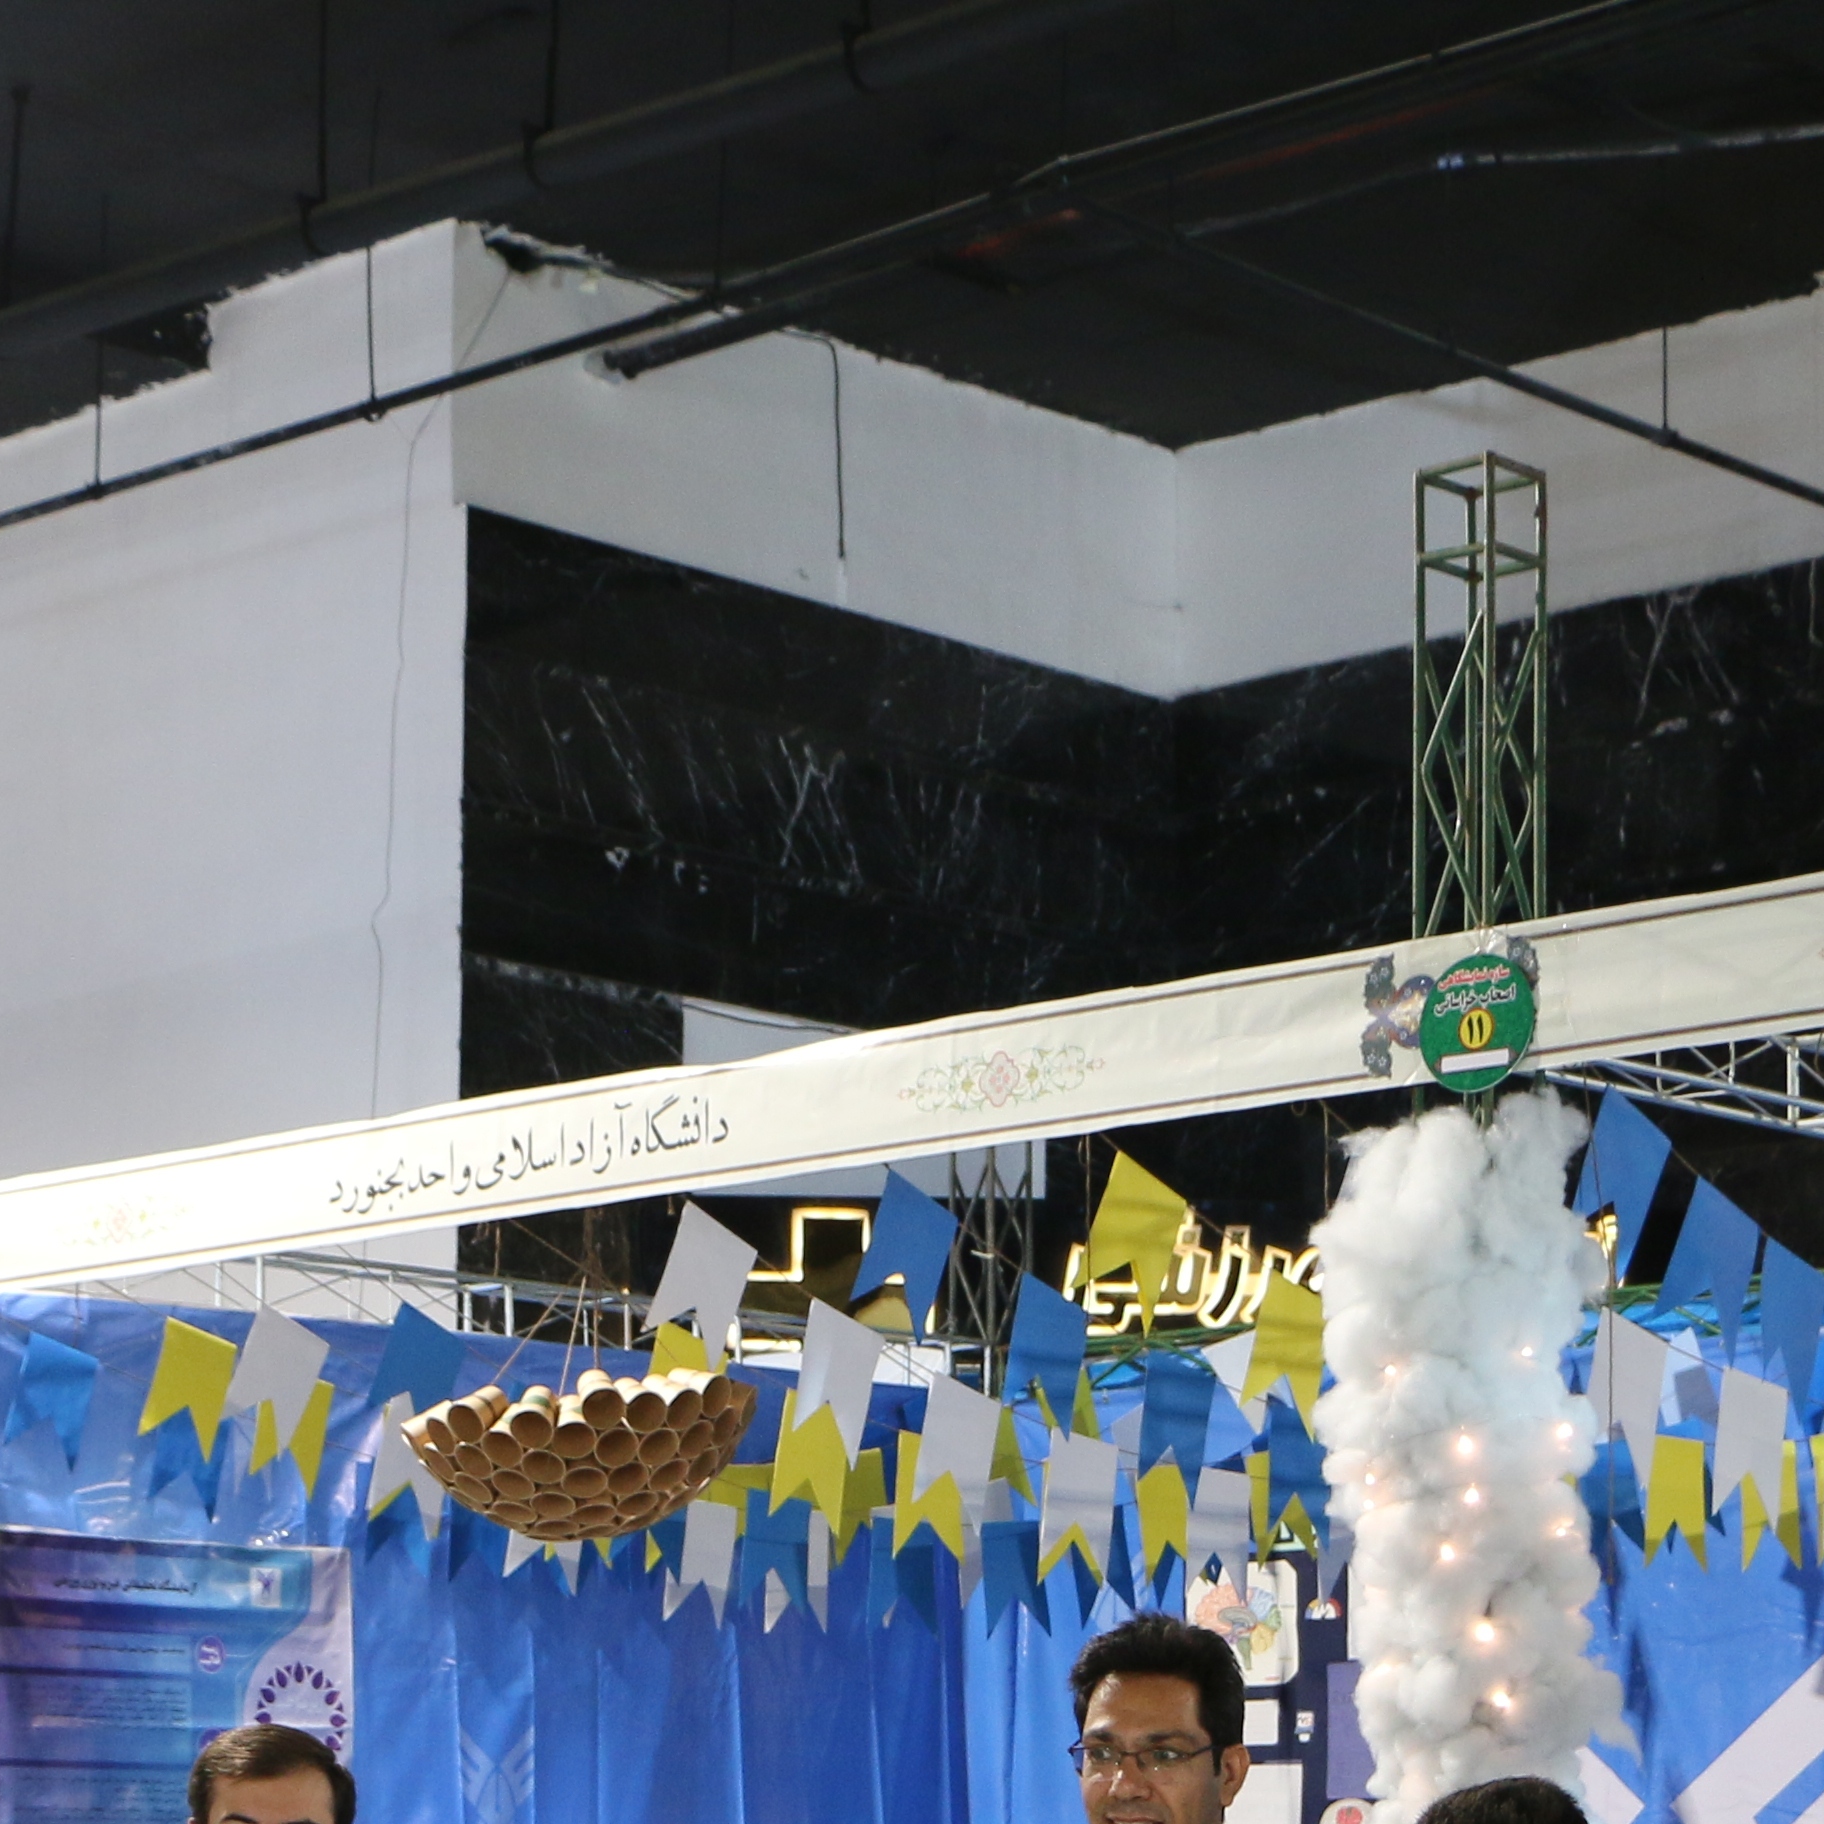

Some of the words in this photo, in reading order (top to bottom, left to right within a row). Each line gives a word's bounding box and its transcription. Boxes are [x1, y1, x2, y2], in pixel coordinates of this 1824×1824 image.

[1434, 989, 1479, 1016] خراسانی
[1437, 967, 1488, 991] نمایشگاهی
[570, 1102, 632, 1174] آزاد
[631, 1093, 729, 1157] دانشگاه
[407, 1140, 472, 1196] واحد
[475, 1122, 565, 1190] اسلامی
[329, 1157, 404, 1213] بجنورد
